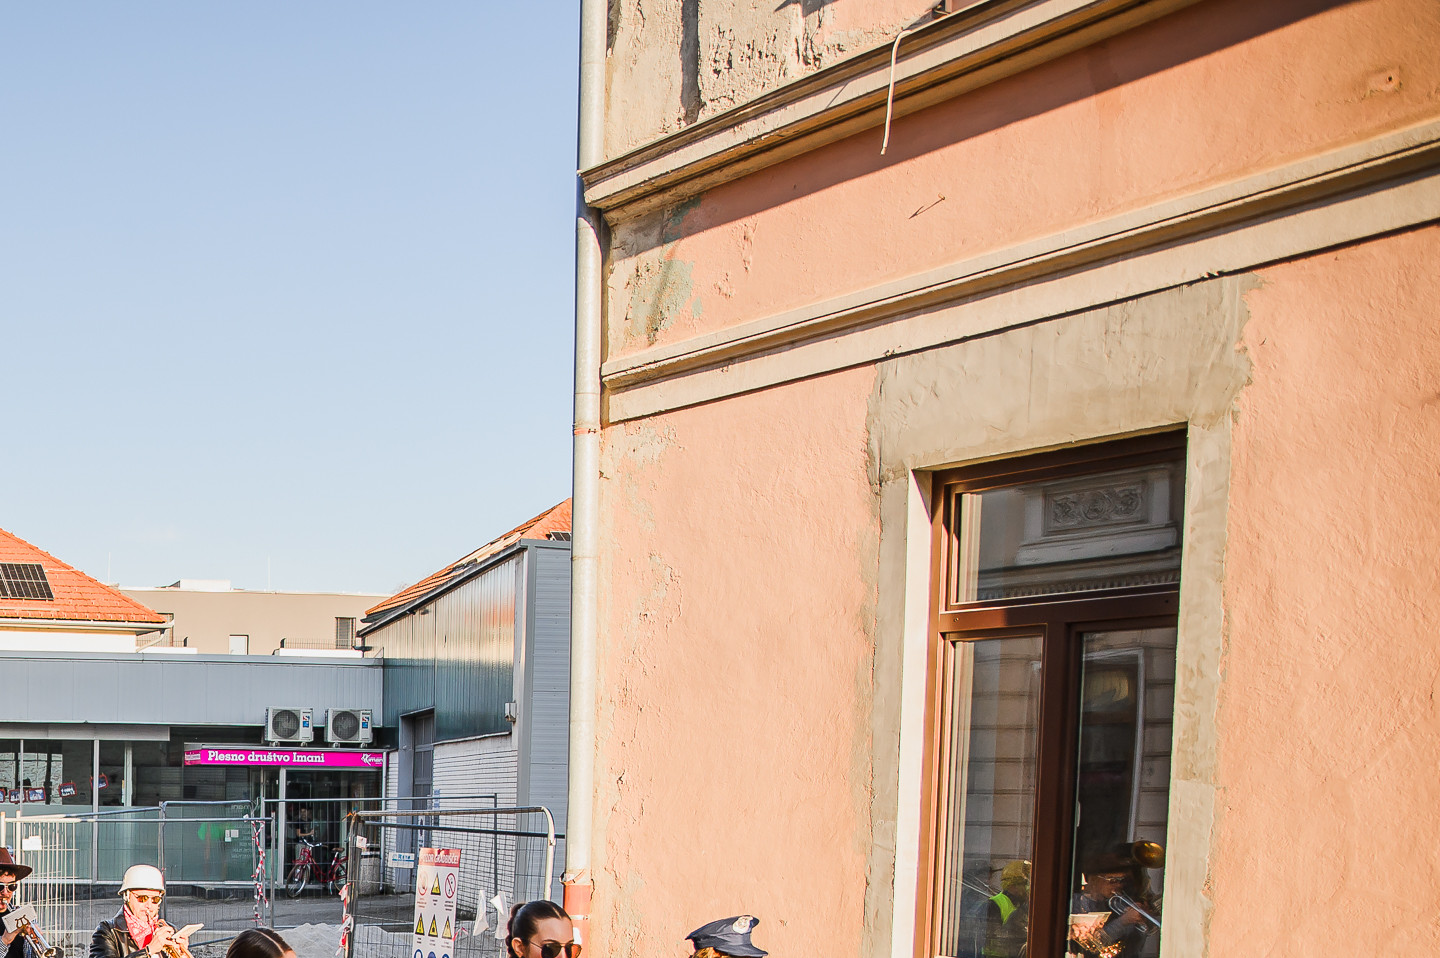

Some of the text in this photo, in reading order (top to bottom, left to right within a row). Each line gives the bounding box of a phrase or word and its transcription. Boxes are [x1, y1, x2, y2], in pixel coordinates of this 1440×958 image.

[207, 750, 245, 762] Plesno
[247, 751, 290, 763] društvo
[292, 752, 325, 763] Imani
